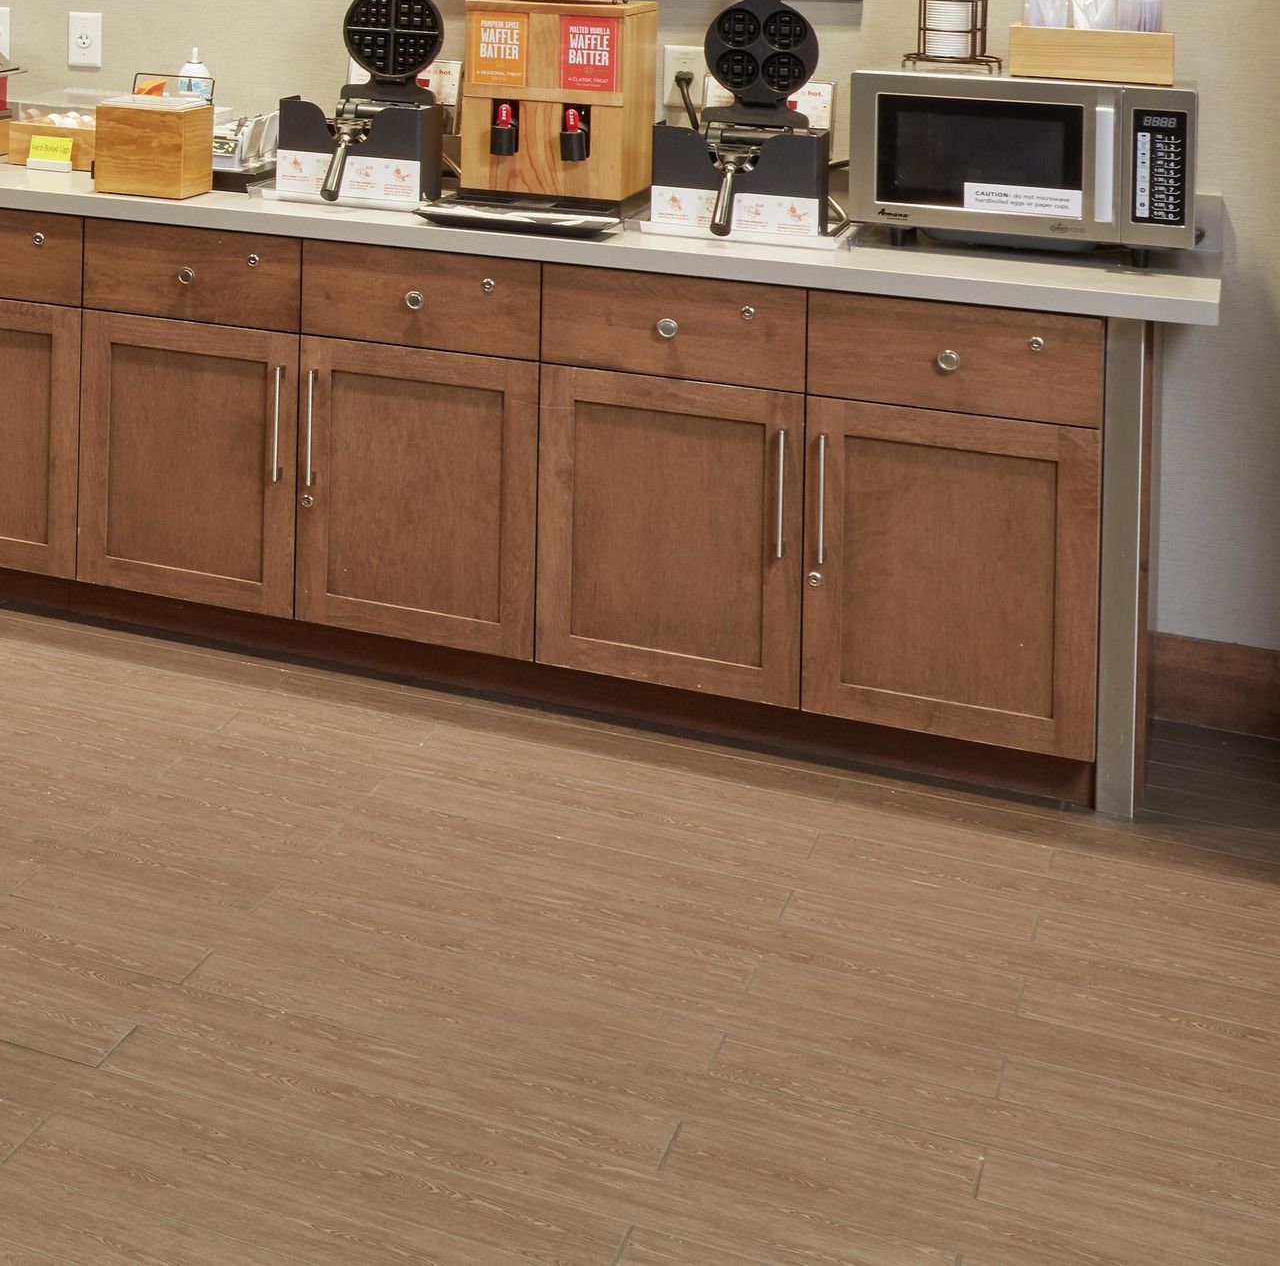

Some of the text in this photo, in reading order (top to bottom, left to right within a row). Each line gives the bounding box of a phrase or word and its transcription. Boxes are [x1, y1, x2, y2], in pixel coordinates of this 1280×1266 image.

[480, 20, 520, 29] PUMPKIN SPICE
[480, 28, 520, 44] WAFFLE
[569, 34, 610, 50] WAFFLE
[480, 43, 519, 59] BATTER
[569, 49, 609, 66] BATTER
[975, 190, 1011, 198] CAUTION:
